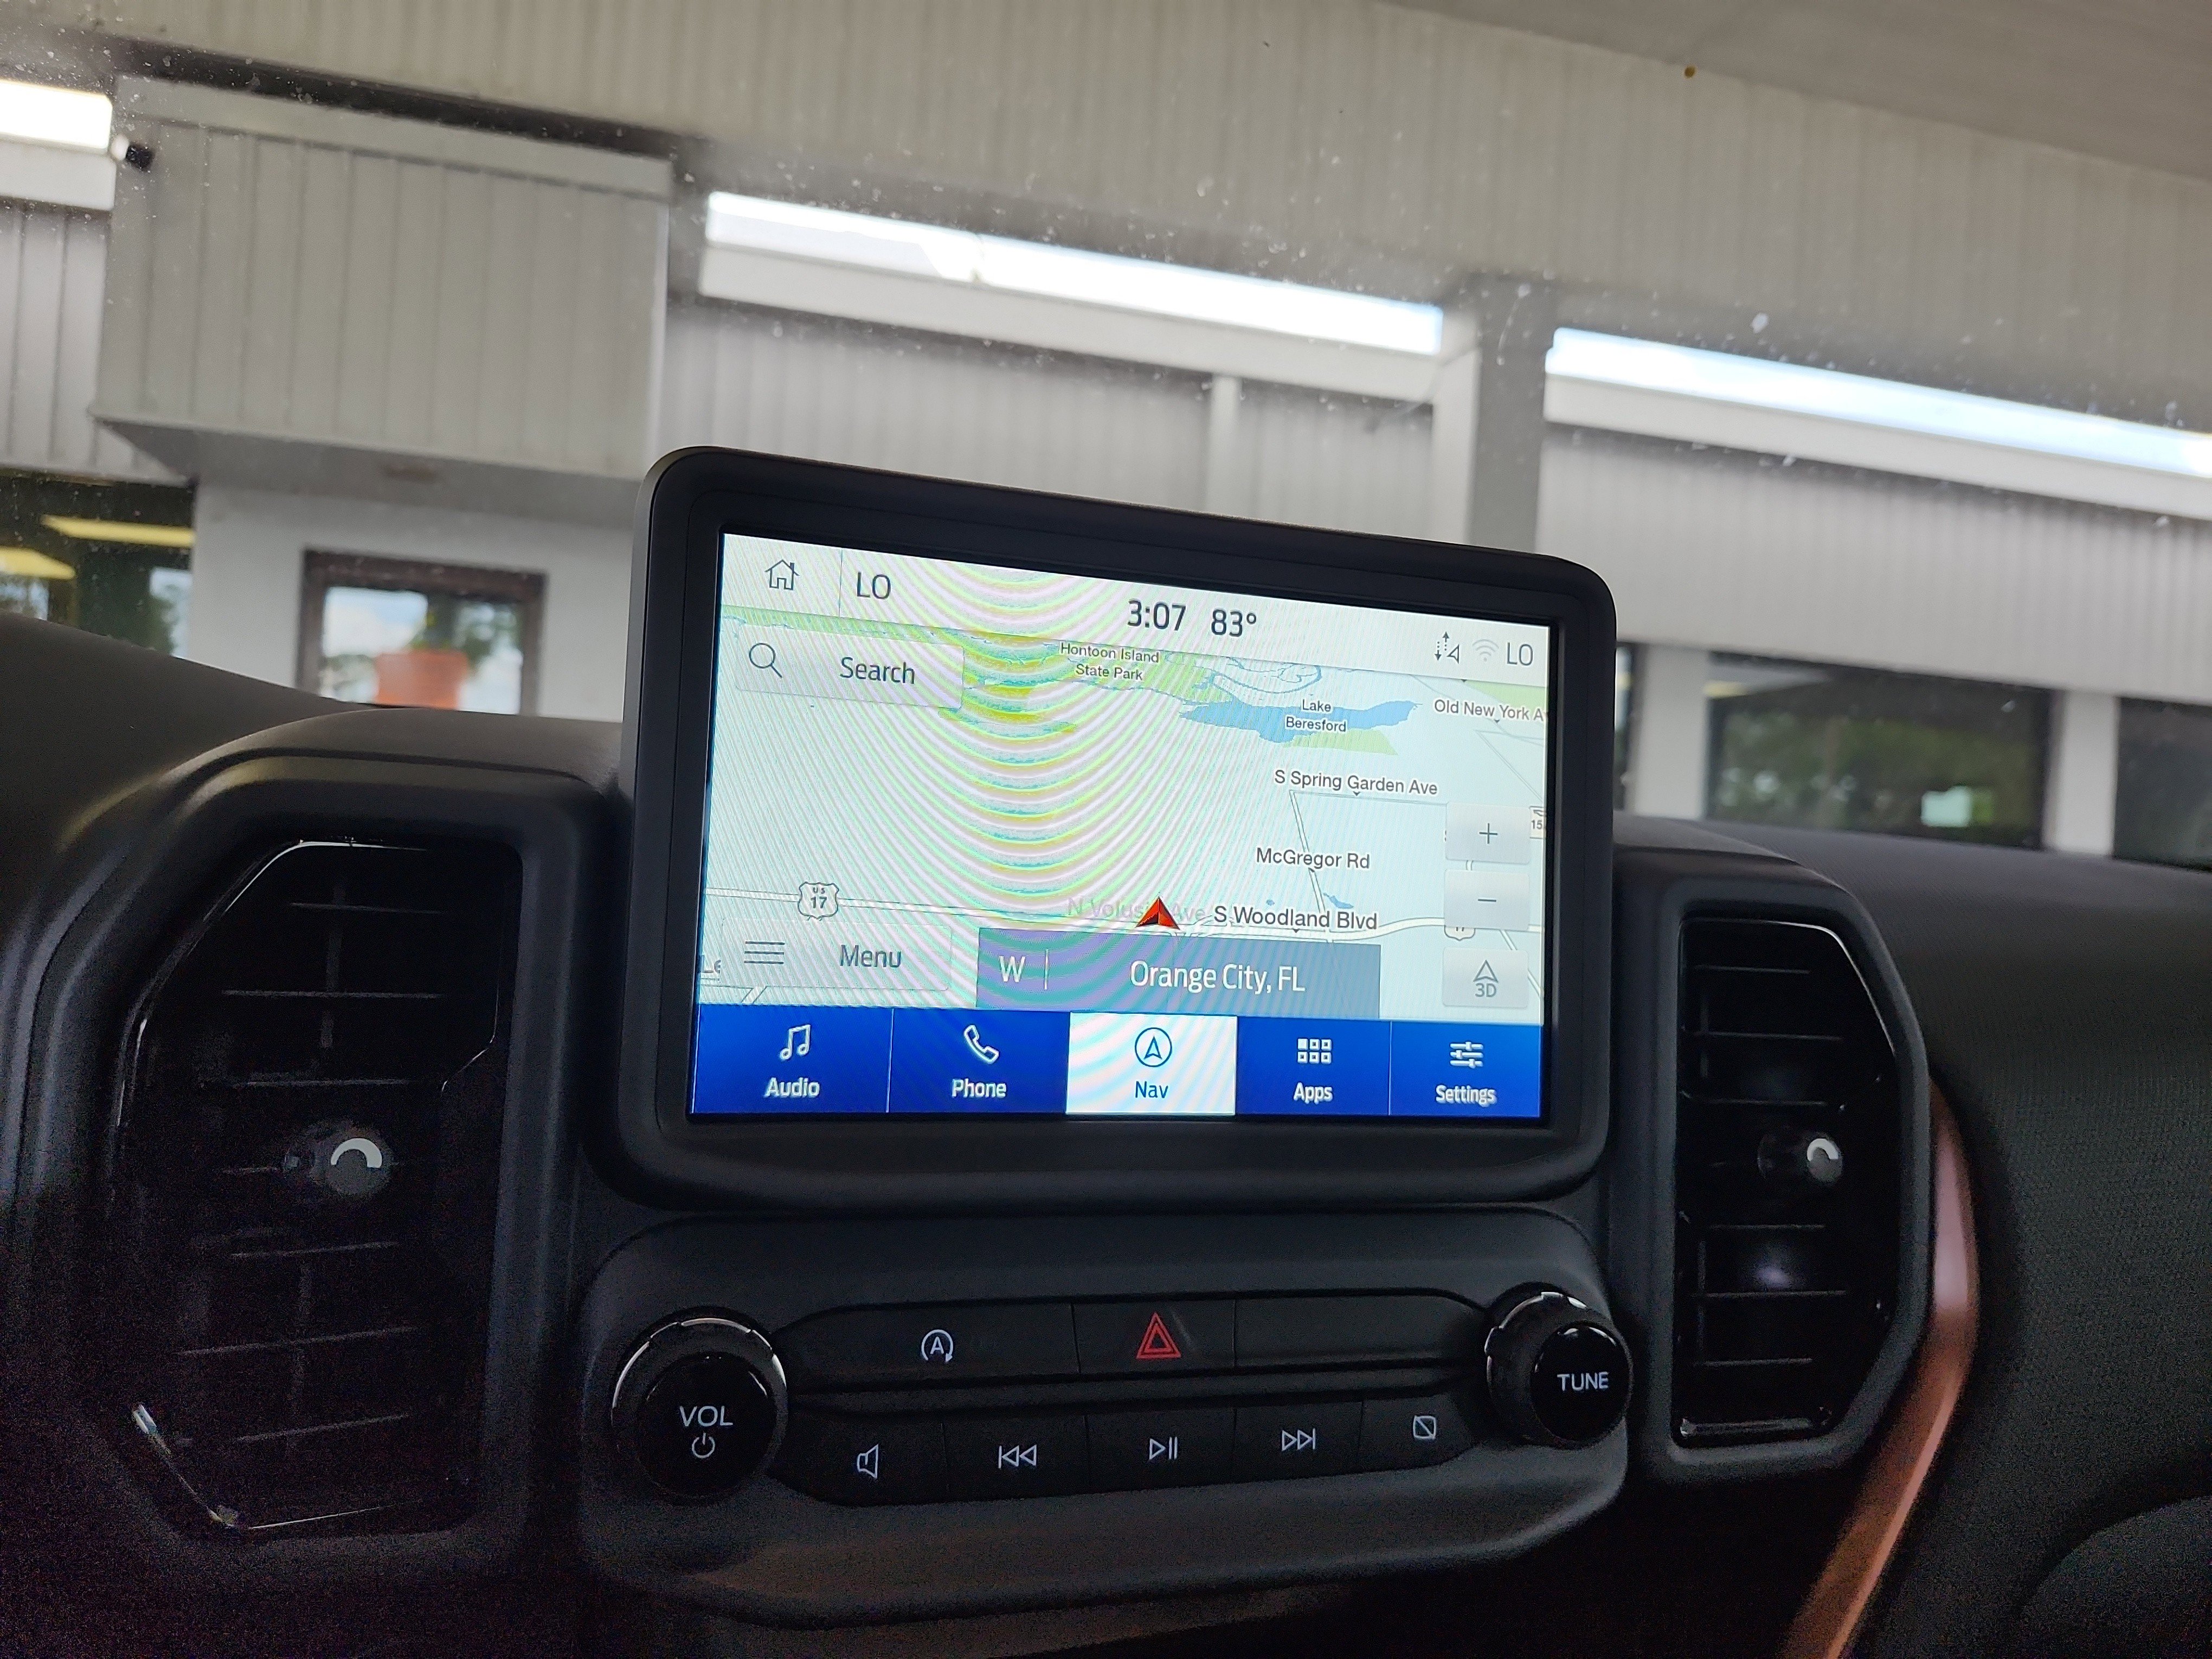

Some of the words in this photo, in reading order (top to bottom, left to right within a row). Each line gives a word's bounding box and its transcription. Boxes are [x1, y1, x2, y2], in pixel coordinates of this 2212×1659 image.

[857, 571, 891, 600] LO
[1127, 599, 1186, 631] 3:07
[1211, 608, 1257, 637] 83°
[1060, 642, 1116, 659] Hontoon
[1121, 648, 1159, 664] Island
[1507, 642, 1533, 666] LO
[840, 657, 915, 685] Search
[1076, 663, 1110, 677] State
[1114, 667, 1143, 681] Park
[1302, 699, 1331, 712] Lake
[1435, 699, 1459, 713] Old
[1464, 701, 1495, 717] New
[1499, 704, 1529, 721] York
[1286, 716, 1346, 732] Beresford
[1274, 769, 1285, 784] S
[1290, 770, 1342, 790] Spring
[1347, 775, 1404, 793] Garden
[1409, 780, 1438, 795] Ave
[1256, 847, 1342, 870] McGregor
[1347, 852, 1369, 869] Rd
[811, 896, 827, 909] 17
[1214, 905, 1227, 923] S
[1233, 906, 1330, 928] Woodland
[1337, 911, 1377, 930] Blvd
[840, 944, 902, 968] Menu
[998, 955, 1026, 982] W
[1130, 960, 1217, 993] Orange
[1223, 963, 1271, 995] City,
[1278, 966, 1306, 992] FL
[1475, 982, 1497, 998] 3D
[764, 1077, 820, 1098] Audio
[951, 1078, 1007, 1098] Phone
[1135, 1081, 1169, 1099] Nav
[1293, 1082, 1333, 1104] Apps
[1436, 1084, 1497, 1107] Settings
[1557, 1371, 1609, 1392] TUNE
[679, 1405, 734, 1427] VOL
